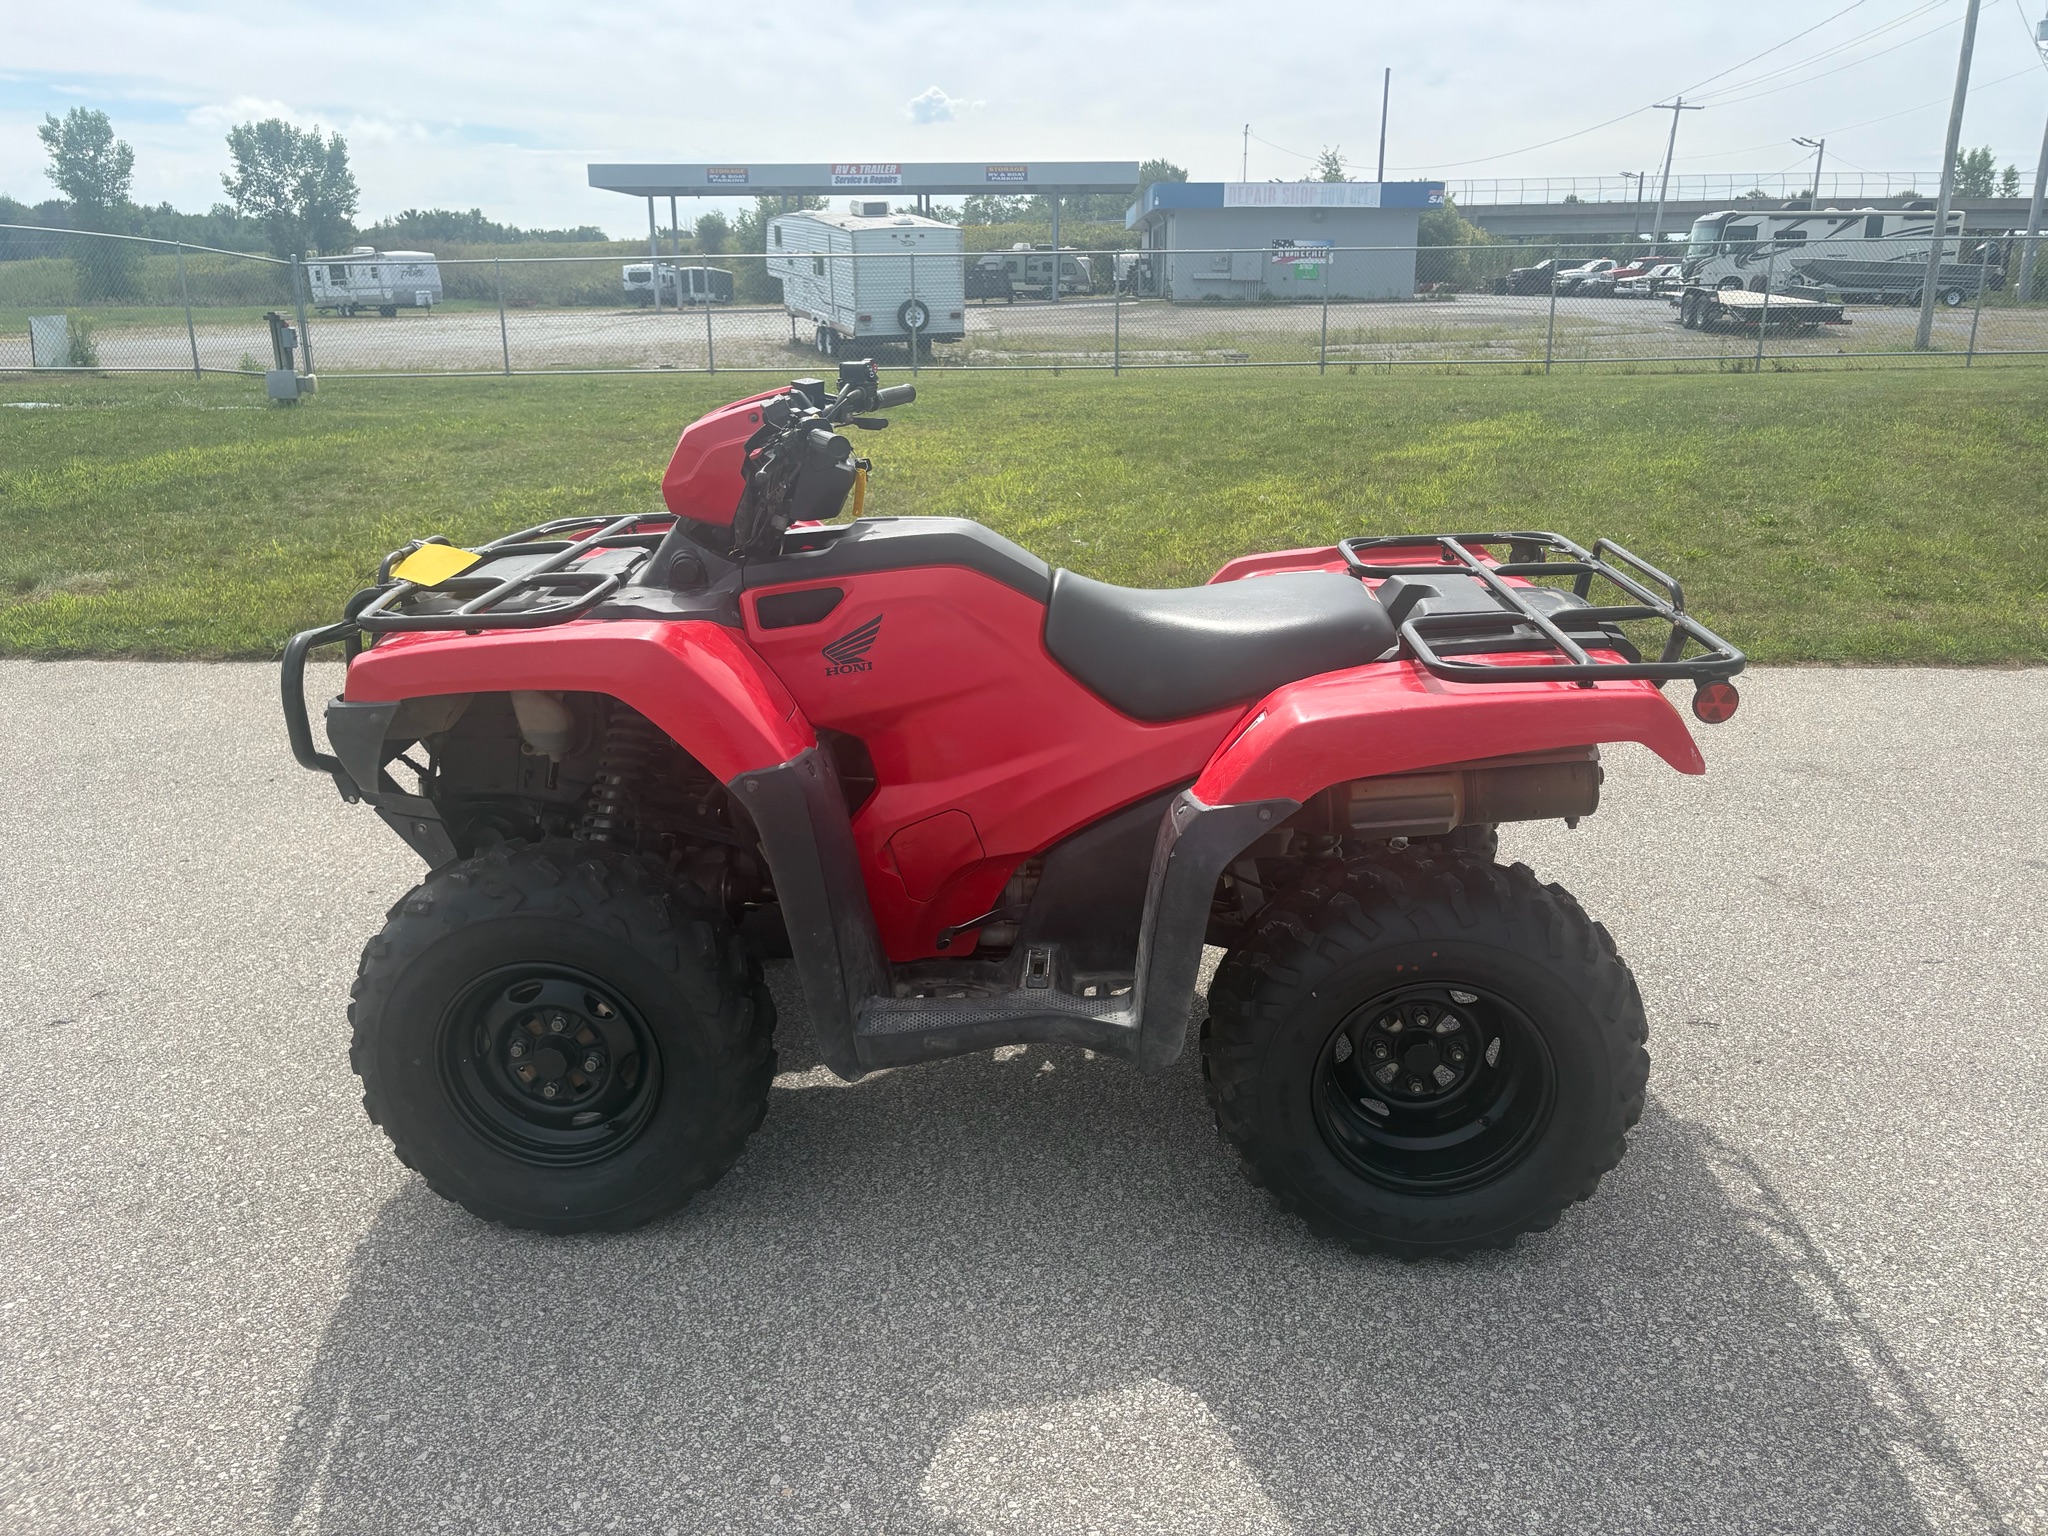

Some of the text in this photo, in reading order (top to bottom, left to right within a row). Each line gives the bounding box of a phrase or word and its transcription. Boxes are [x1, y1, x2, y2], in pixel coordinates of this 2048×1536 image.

[835, 164, 897, 174] RV & TRAILER
[833, 175, 898, 185] Service & Repairs
[1228, 186, 1276, 205] REPAIR
[1282, 186, 1318, 205] SHOP
